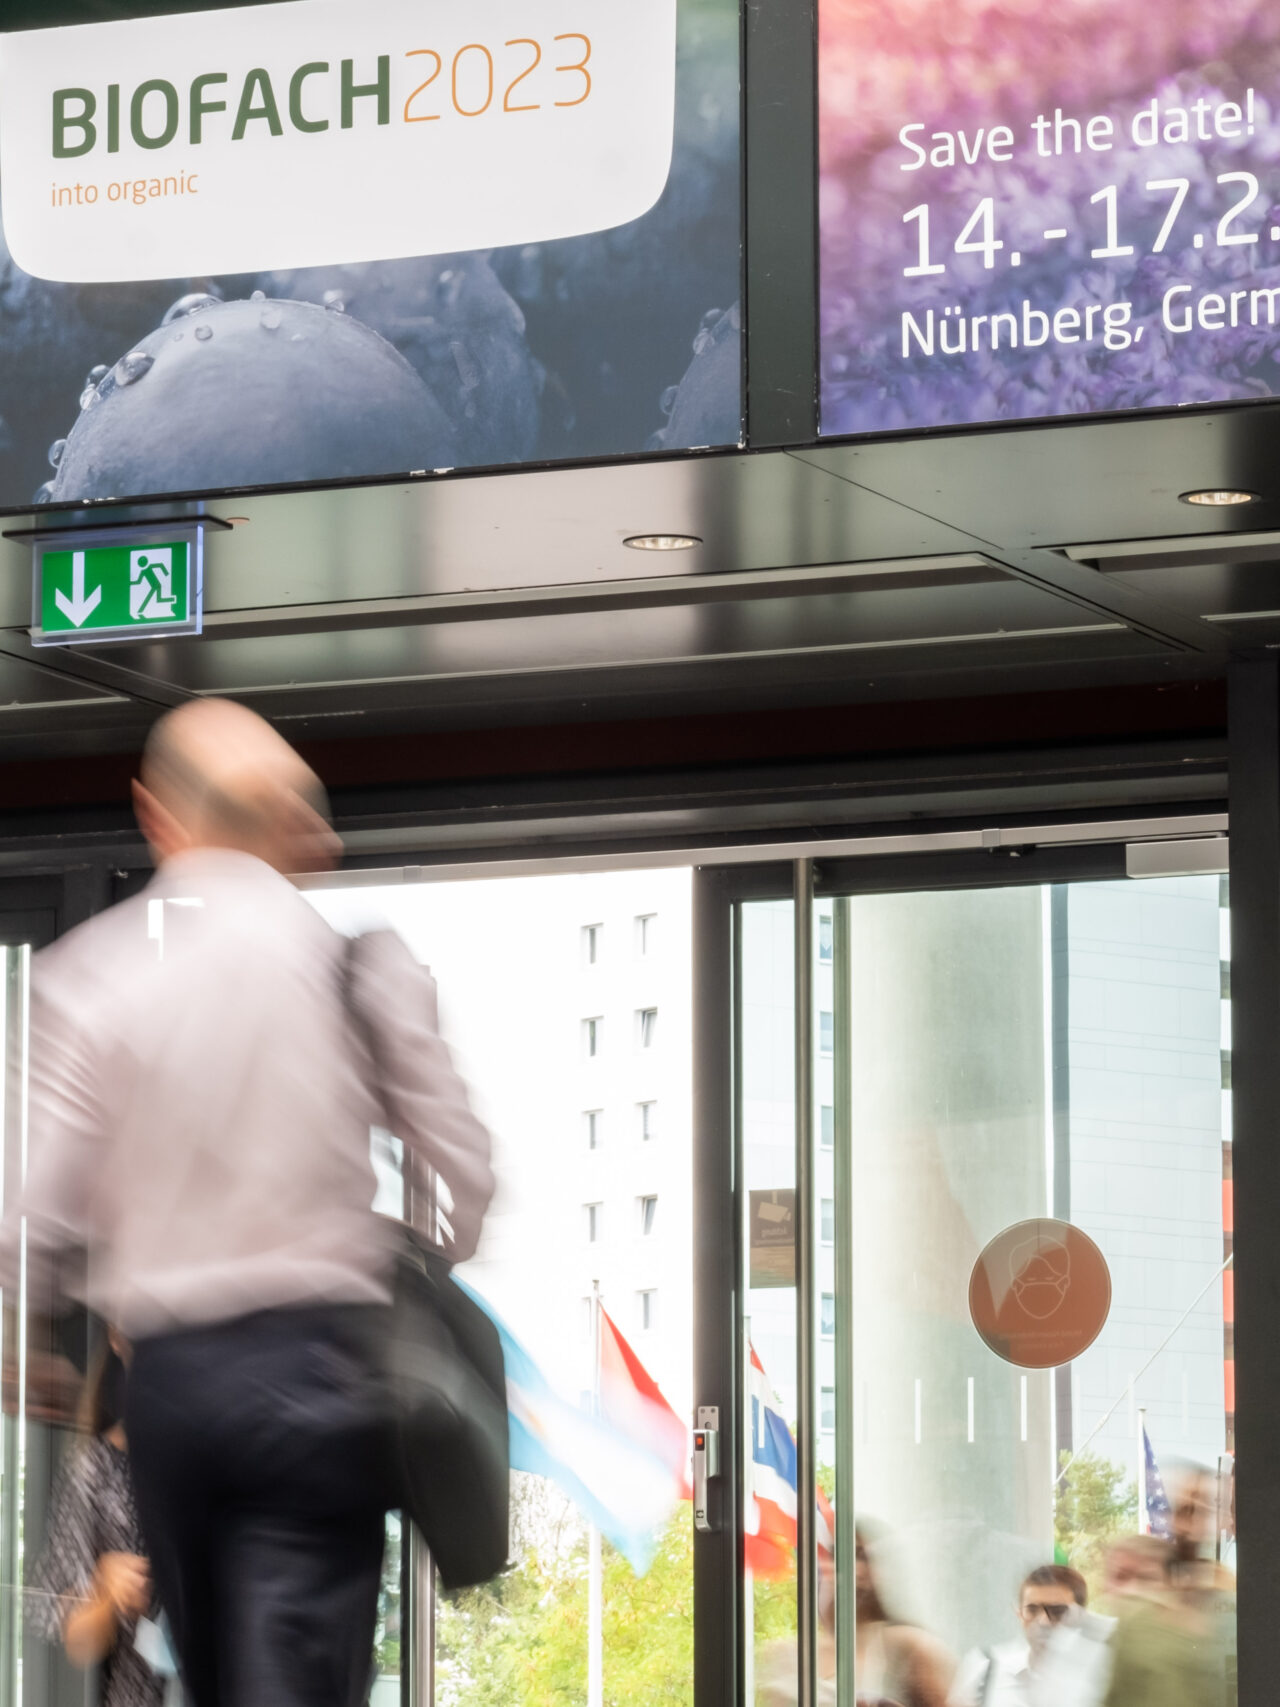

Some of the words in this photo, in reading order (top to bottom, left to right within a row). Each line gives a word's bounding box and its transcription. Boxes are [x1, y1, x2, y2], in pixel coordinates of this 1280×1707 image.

[898, 123, 1015, 171] Save
[1030, 108, 1114, 157] the
[1131, 88, 1255, 147] date!
[51, 178, 99, 207] into
[107, 170, 199, 205] organic
[901, 299, 1145, 358] Nürnberg,
